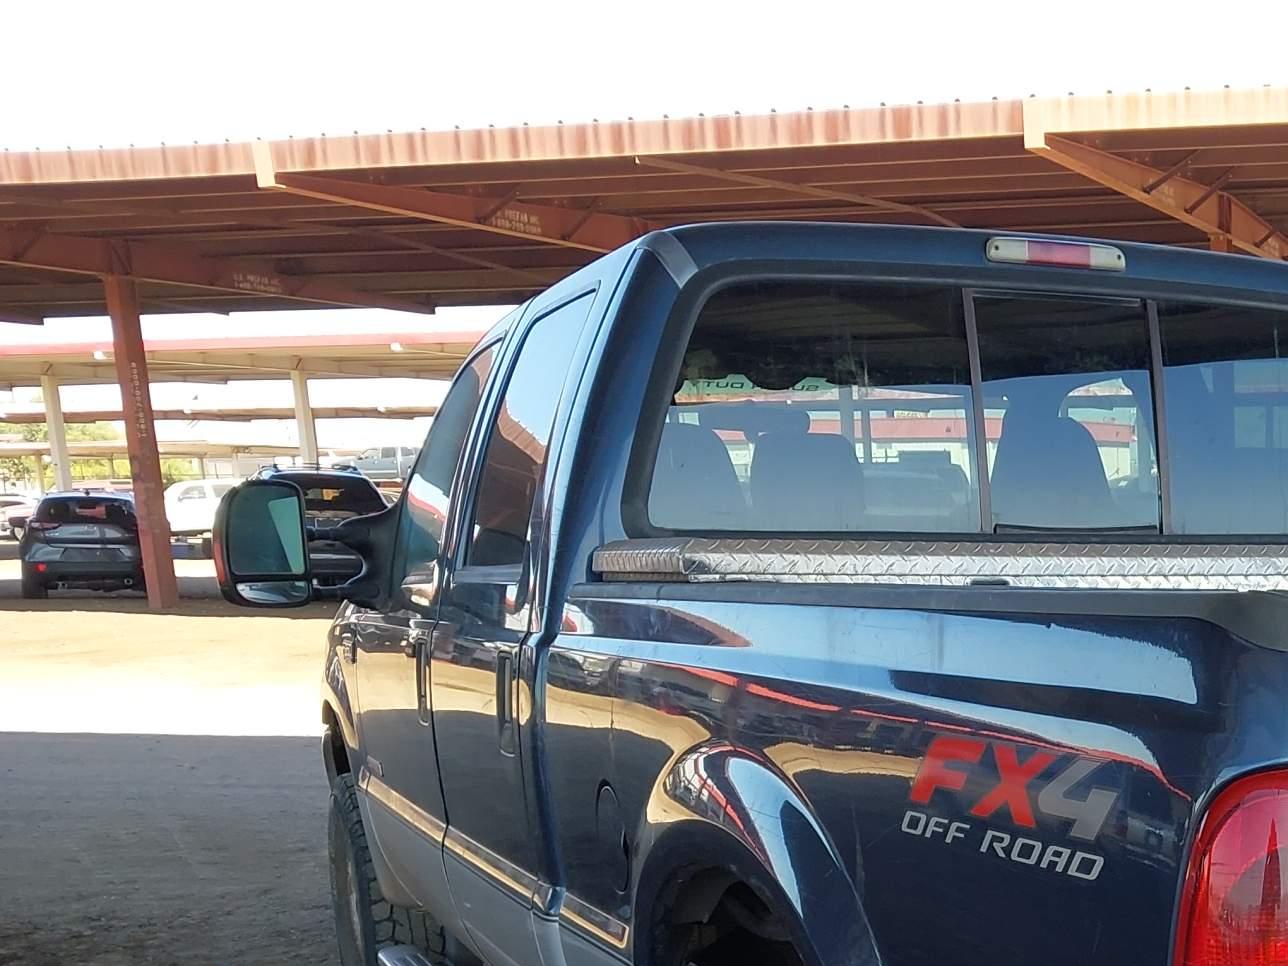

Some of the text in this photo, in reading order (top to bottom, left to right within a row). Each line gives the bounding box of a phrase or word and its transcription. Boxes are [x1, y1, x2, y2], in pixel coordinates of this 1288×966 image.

[909, 736, 1119, 841] FX4
[901, 811, 1104, 881] OFF ROAD
